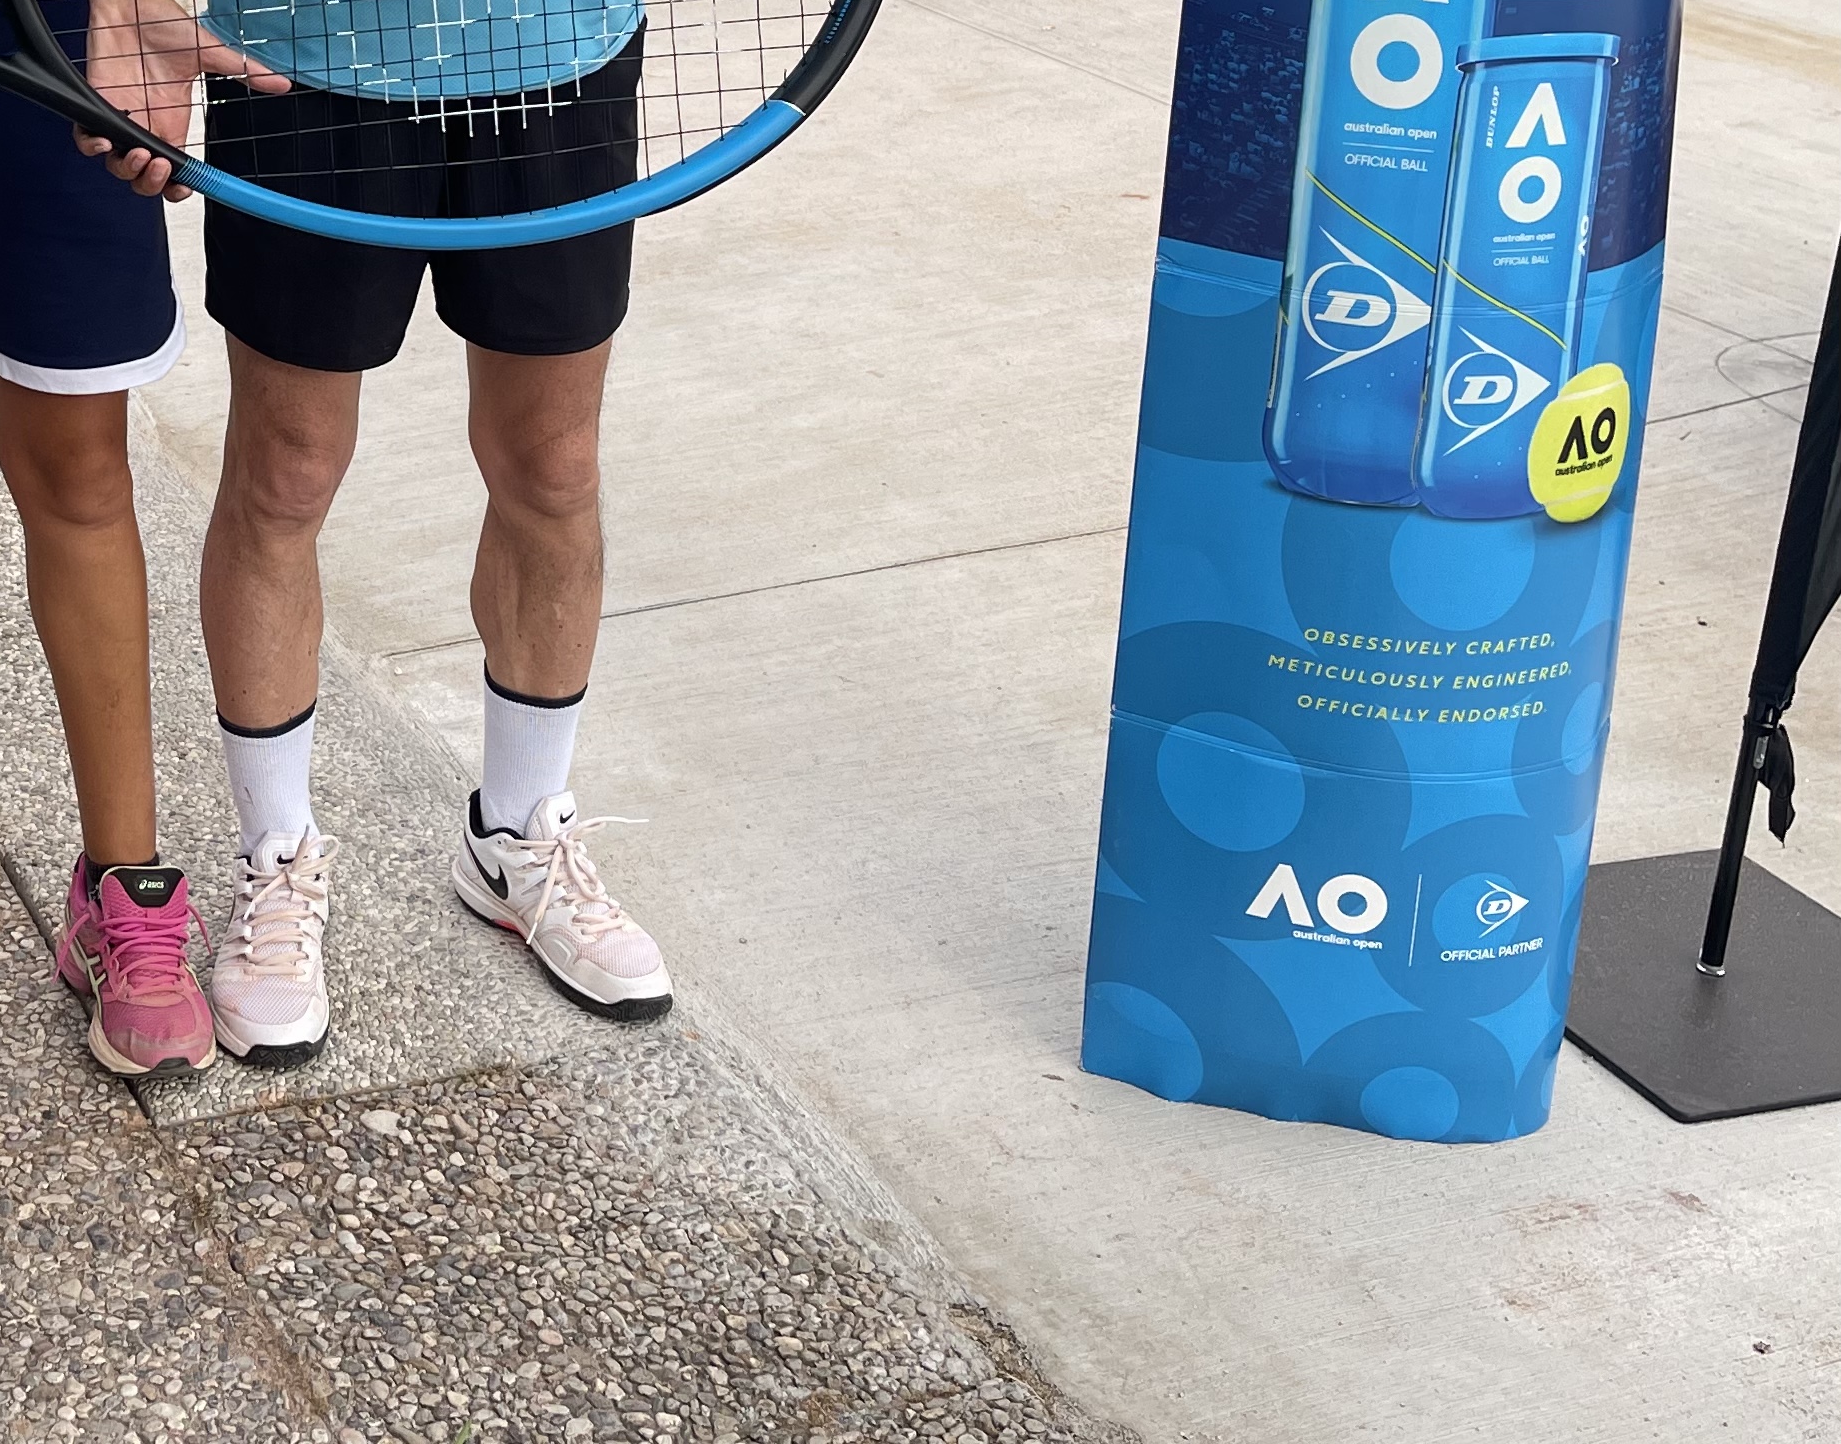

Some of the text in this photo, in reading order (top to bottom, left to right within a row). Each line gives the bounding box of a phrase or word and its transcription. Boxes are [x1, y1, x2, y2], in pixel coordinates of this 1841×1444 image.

[1485, 85, 1500, 149] DUNLOP
[1344, 120, 1438, 141] australian open
[1344, 153, 1429, 173] OFFICIAL BALL
[1492, 232, 1556, 243] australian open
[1493, 253, 1550, 267] OFFICIAL BALL
[1554, 453, 1614, 477] australian open
[1304, 628, 1557, 657] OBSESSIVELY CRAFTED,
[1267, 654, 1573, 690] METICULOUSLY ENGINEERED,
[1297, 694, 1548, 724] OFFICIALLY ENDORSED.
[1292, 929, 1384, 951] australian open
[1440, 937, 1544, 963] OFFICIAL PARTNER
